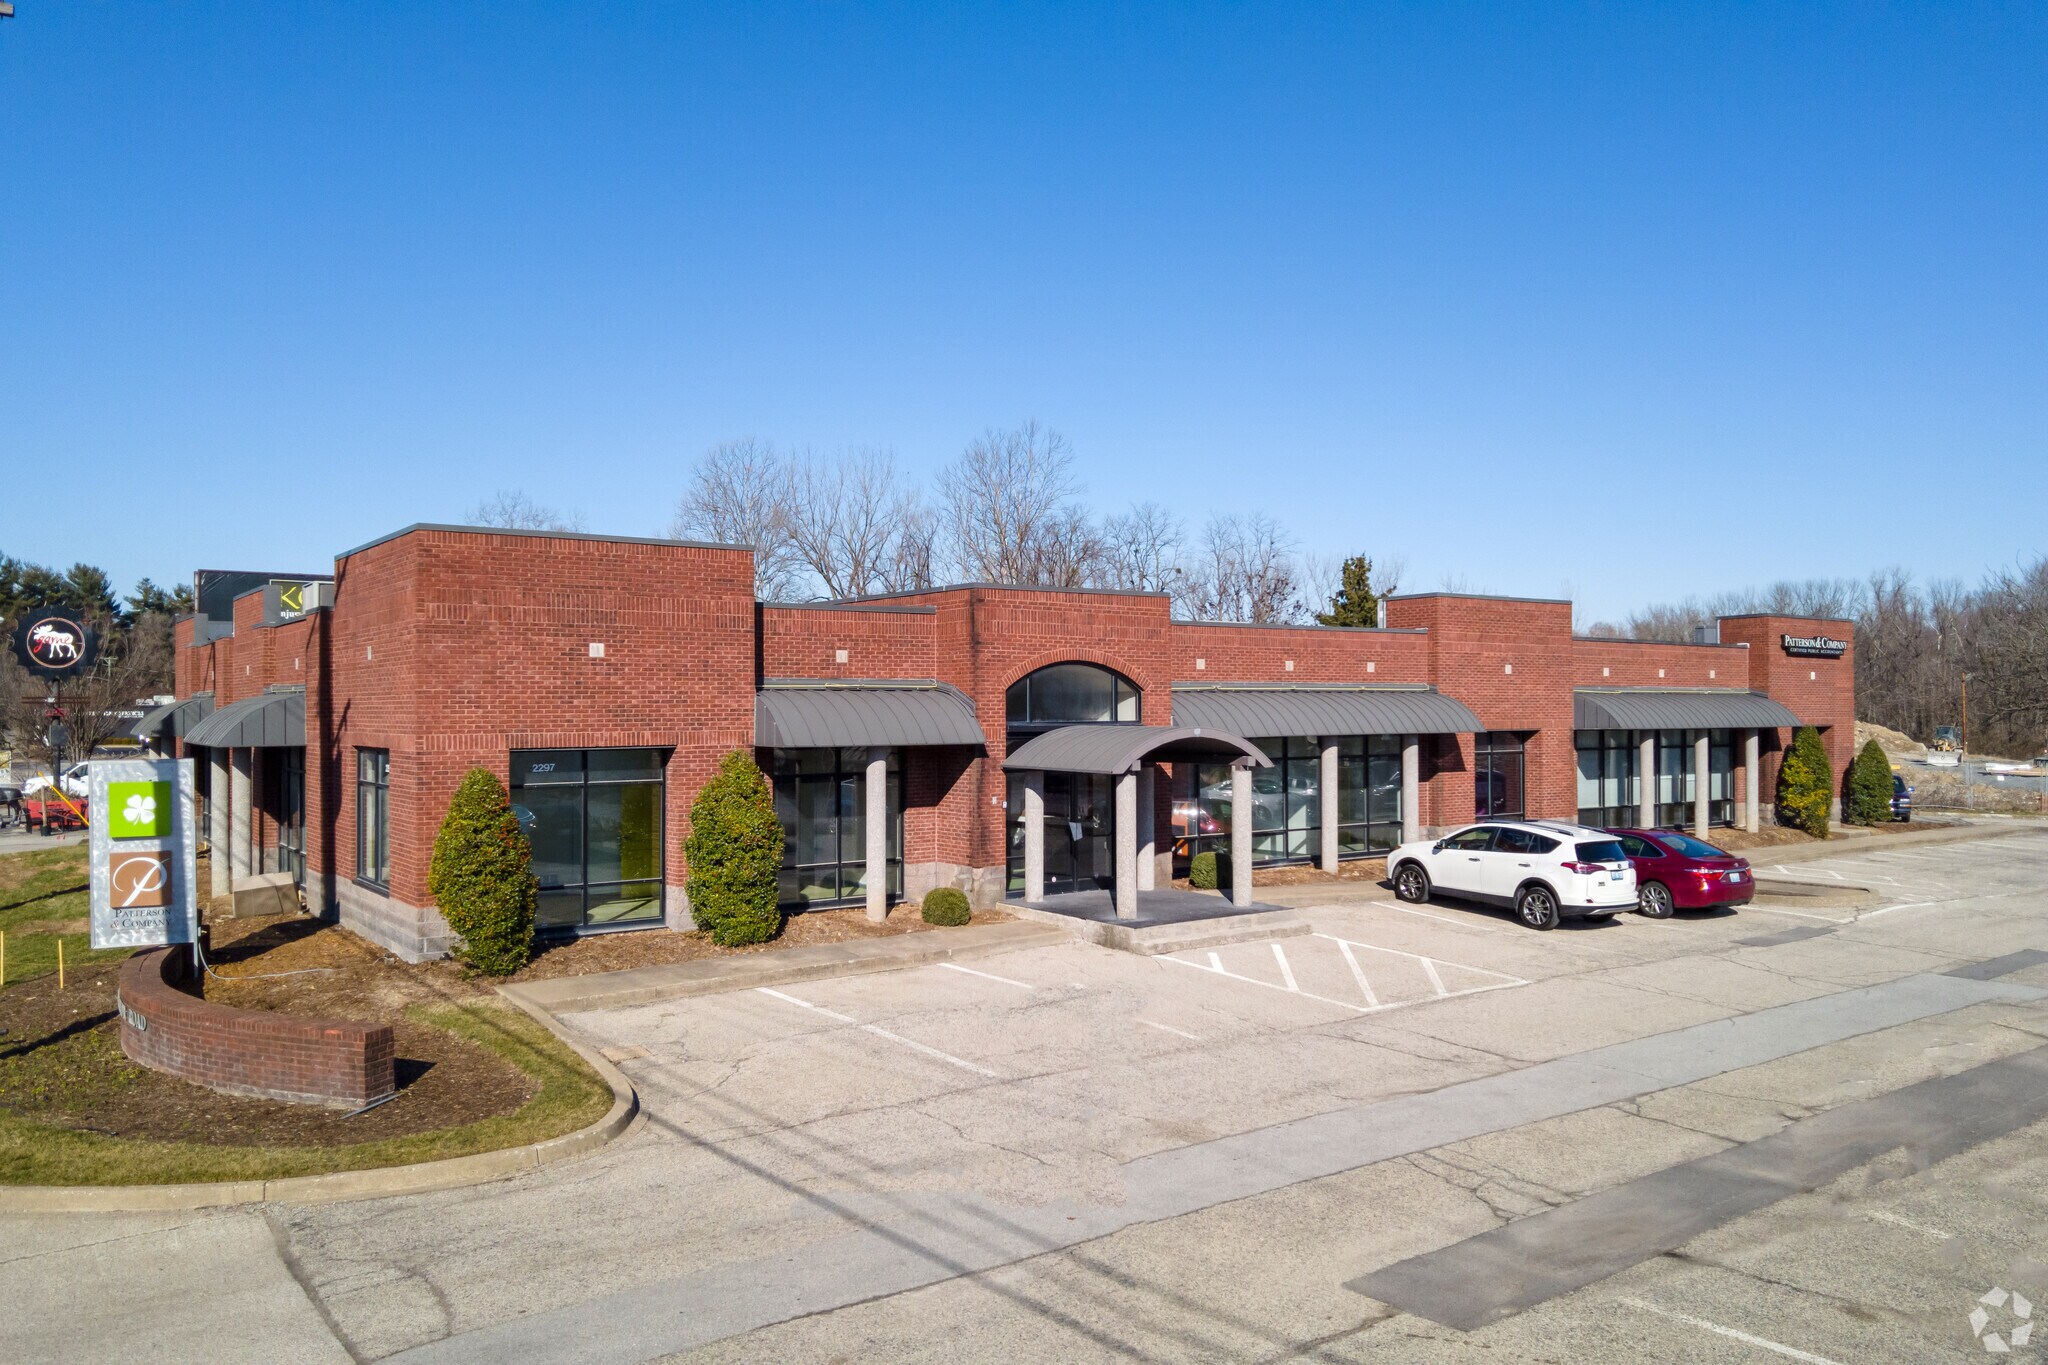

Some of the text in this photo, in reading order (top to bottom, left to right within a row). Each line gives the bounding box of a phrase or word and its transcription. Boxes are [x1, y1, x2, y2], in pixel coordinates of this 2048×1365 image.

[33, 635, 71, 653] game
[532, 763, 556, 772] 2297
[115, 908, 171, 918] PATTERSON
[110, 918, 171, 928] & COMPANY
